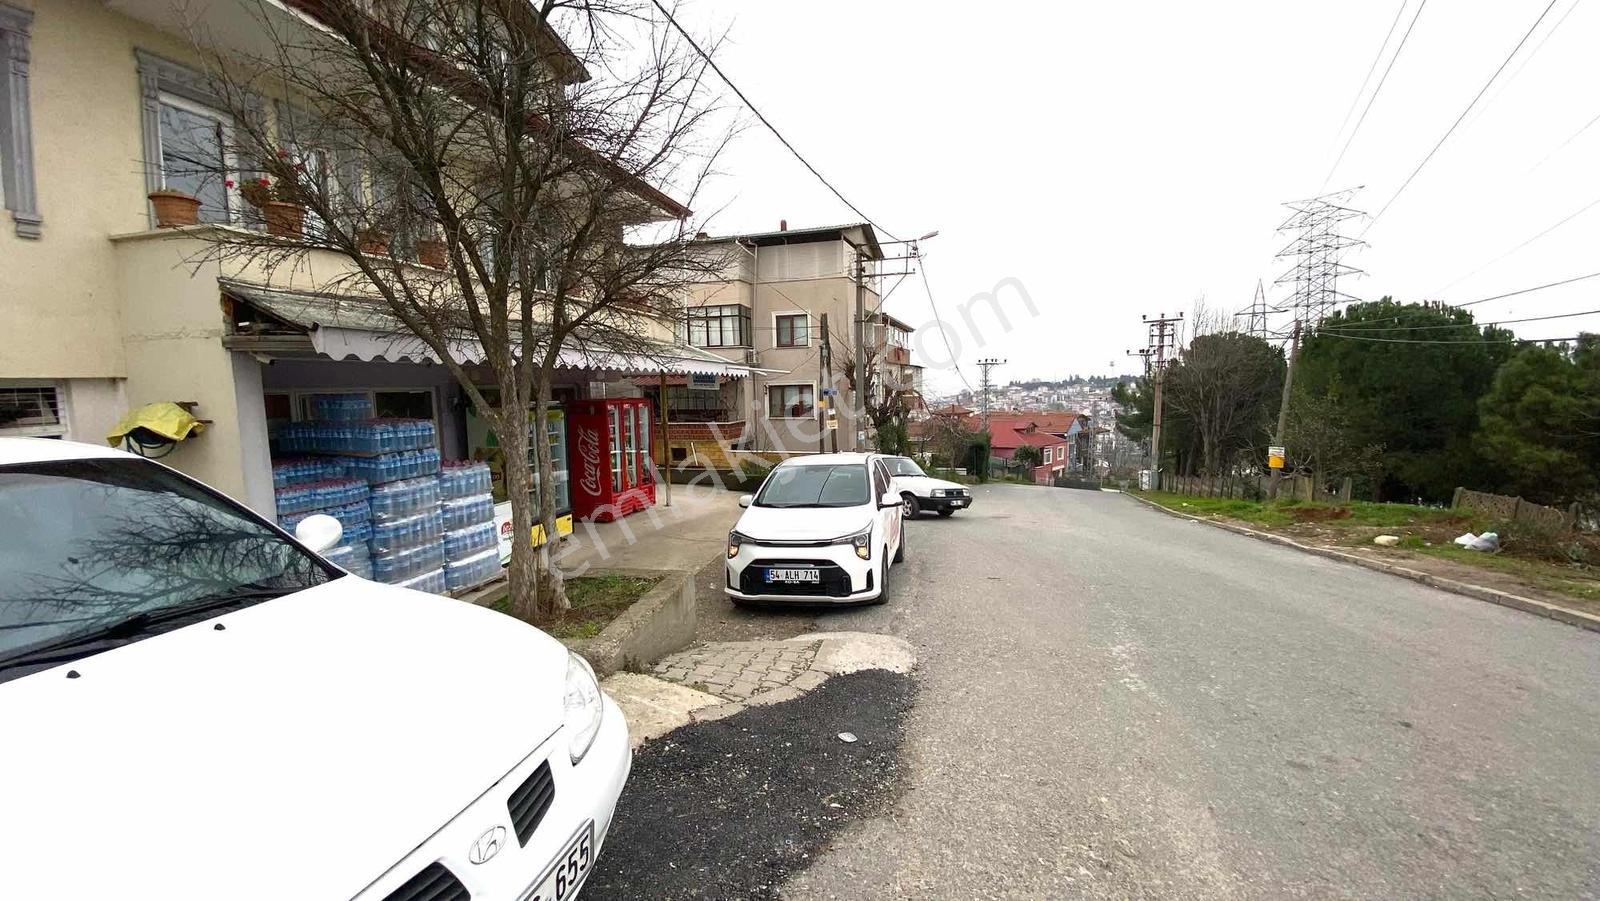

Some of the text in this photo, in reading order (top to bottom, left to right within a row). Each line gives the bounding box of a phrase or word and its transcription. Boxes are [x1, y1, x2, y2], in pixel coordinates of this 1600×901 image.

[770, 570, 819, 580] 54 ALH 714
[556, 833, 589, 901] 655
